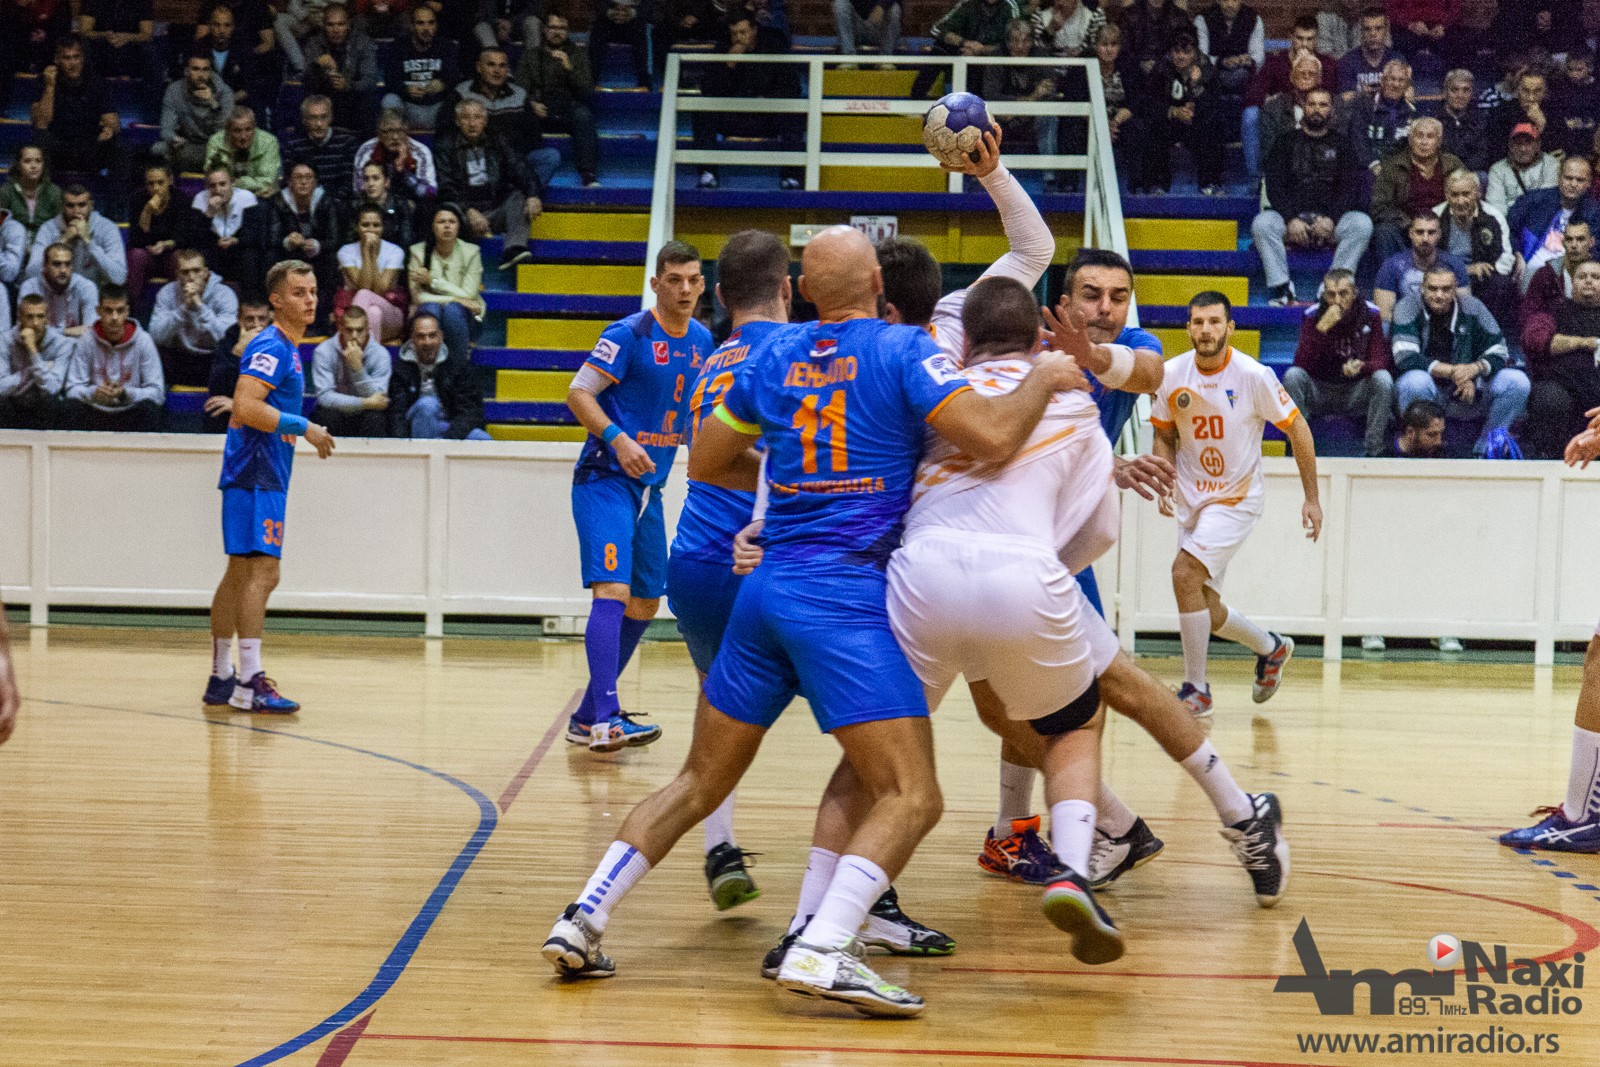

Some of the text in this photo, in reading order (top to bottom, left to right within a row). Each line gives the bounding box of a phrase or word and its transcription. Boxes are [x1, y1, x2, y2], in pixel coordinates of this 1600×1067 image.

[674, 373, 685, 403] 8
[792, 389, 849, 475] 11
[1192, 414, 1225, 441] 20
[263, 518, 283, 547] 33
[603, 542, 619, 572] 8
